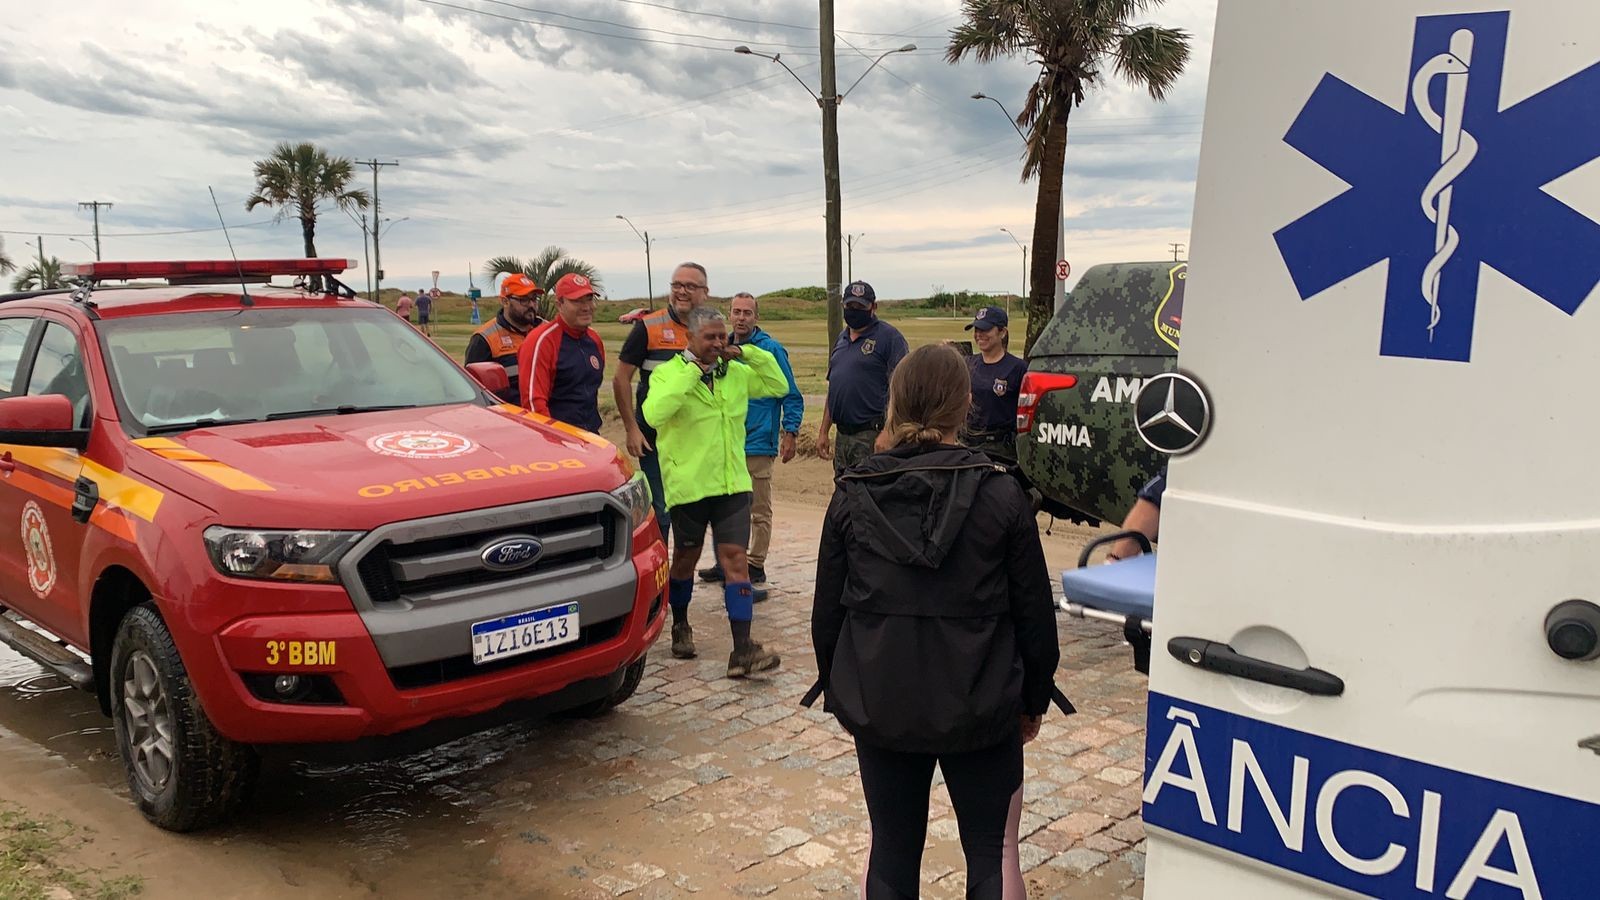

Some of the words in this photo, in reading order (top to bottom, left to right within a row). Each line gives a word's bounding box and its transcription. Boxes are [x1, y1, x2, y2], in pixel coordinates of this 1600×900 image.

[1037, 422, 1092, 448] SMMA
[498, 543, 531, 563] Ford
[518, 616, 535, 624] BRASIL
[1142, 705, 1543, 900] ÂNCIA
